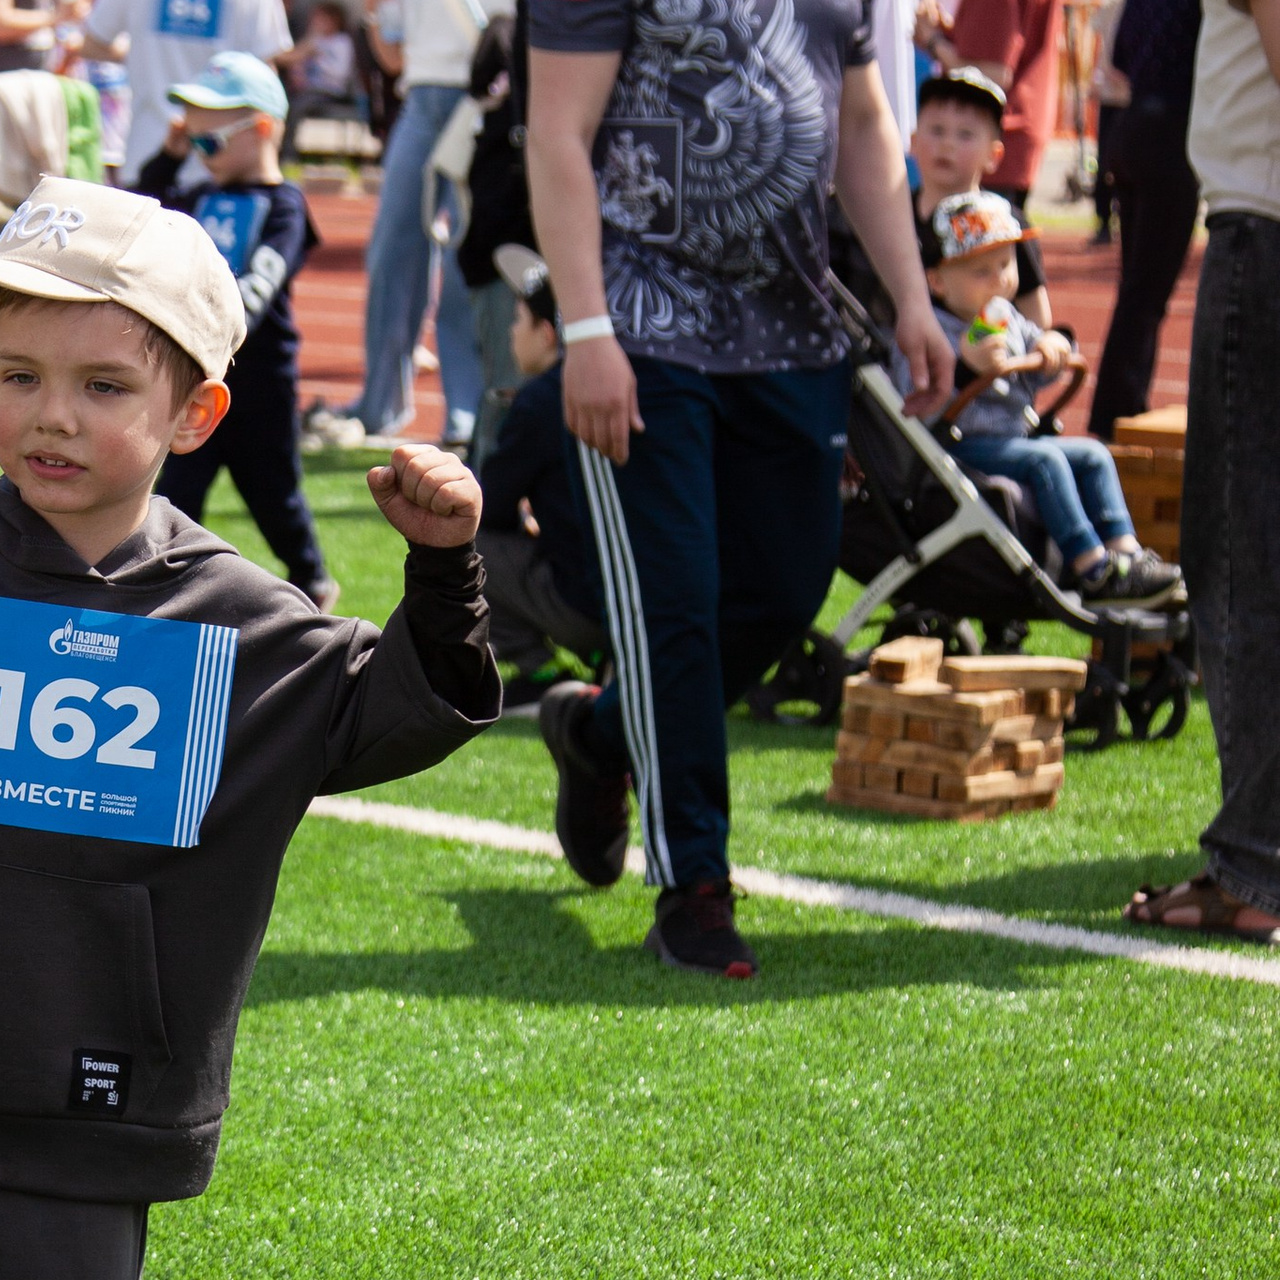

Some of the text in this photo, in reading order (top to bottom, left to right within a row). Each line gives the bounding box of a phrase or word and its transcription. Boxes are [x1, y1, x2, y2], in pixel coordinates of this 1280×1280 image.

[72, 629, 120, 649] ГАЗПРОМ
[73, 644, 116, 655] ПЕРЕРАБОТКА
[70, 651, 117, 663] БЛАГОВЕЩЕНСК
[101, 792, 138, 803] БОЛЬШОЙ
[99, 805, 135, 817] ПИКНИК
[85, 1060, 120, 1073] POWER
[84, 1078, 117, 1090] SPORT
